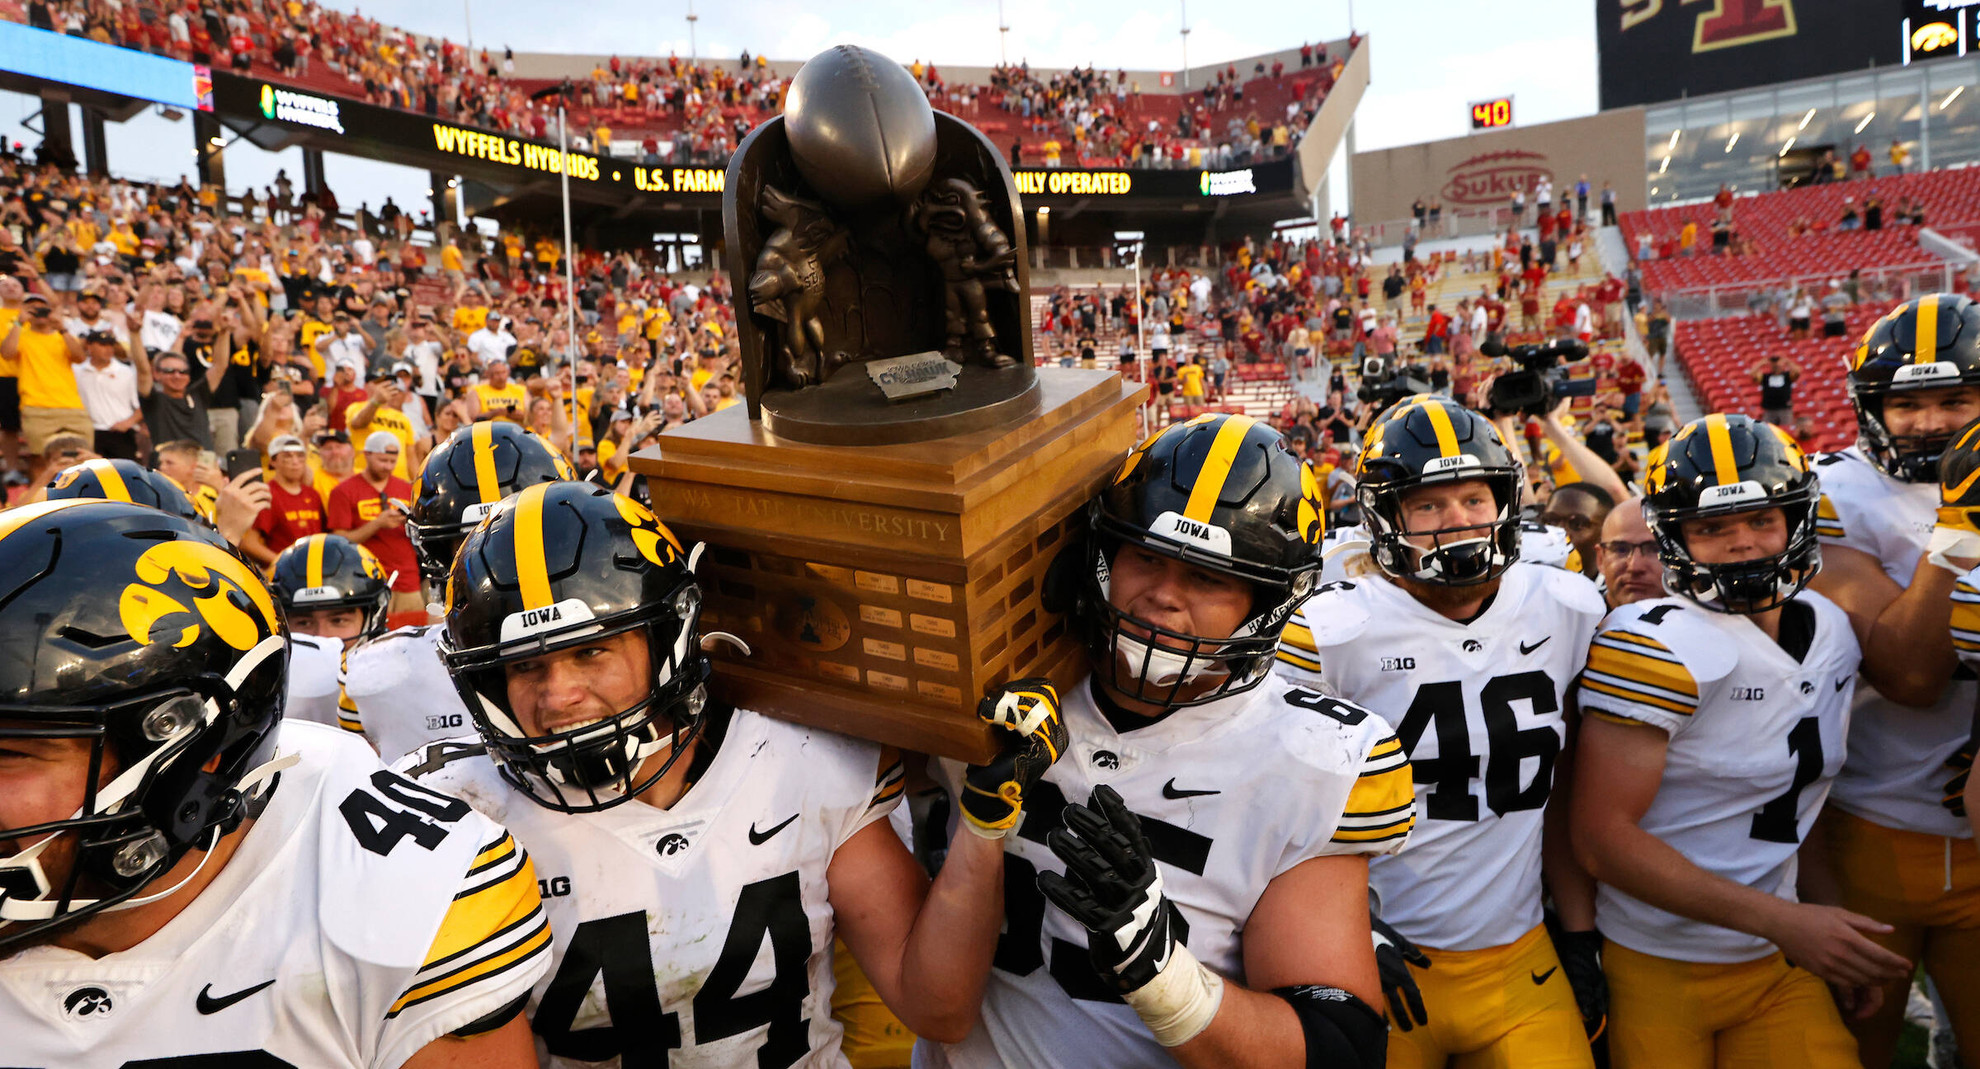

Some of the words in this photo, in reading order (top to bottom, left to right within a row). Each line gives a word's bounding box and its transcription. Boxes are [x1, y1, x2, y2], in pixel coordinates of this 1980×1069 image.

[1473, 99, 1511, 127] 40
[432, 124, 521, 165] WYFFELS
[523, 143, 600, 181] HYBRIDS
[634, 167, 670, 191] U.S.
[1011, 171, 1047, 194] MILY
[1049, 171, 1131, 194] OPERATED
[1911, 366, 1939, 377] IOWA
[1439, 456, 1466, 468] IOWA
[1717, 484, 1746, 496] IOWA
[1174, 519, 1210, 540] IOWA
[304, 588, 325, 597] IOWA
[521, 606, 561, 628] IOWA
[1398, 670, 1560, 821] 46
[1749, 717, 1824, 843] 1
[340, 770, 472, 856] 40
[537, 876, 571, 899] 1G
[531, 870, 813, 1068] 44
